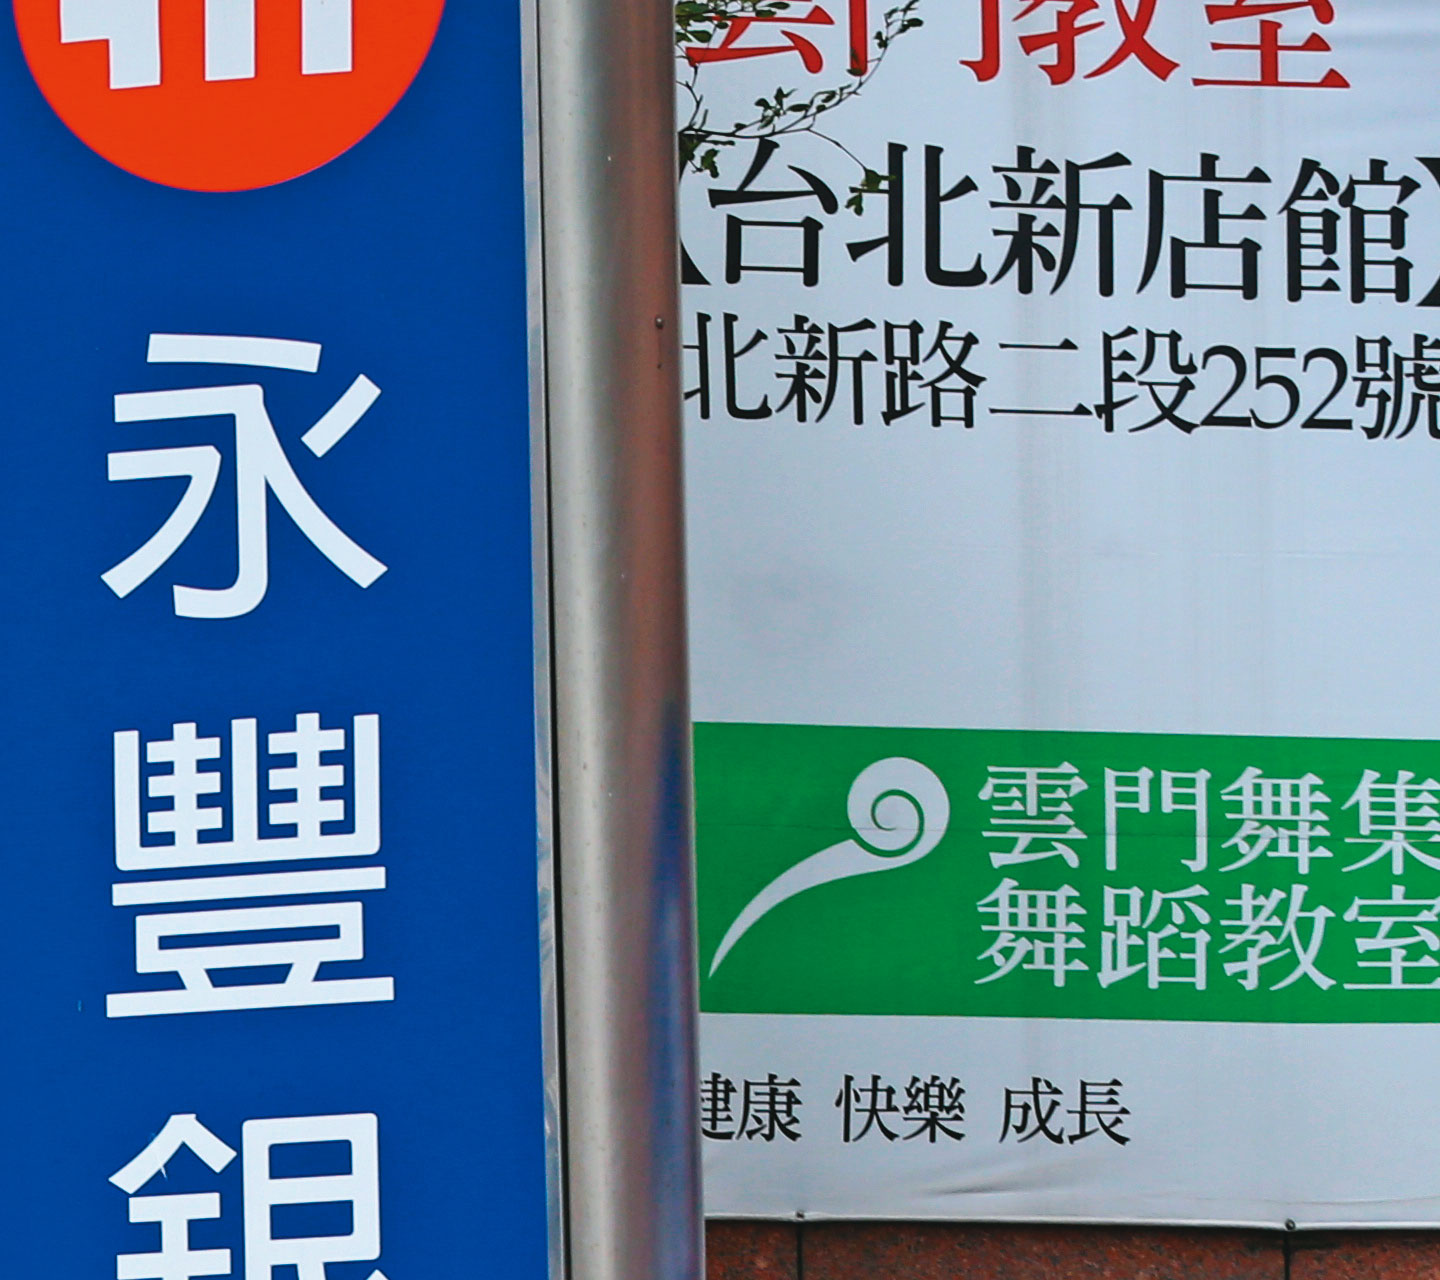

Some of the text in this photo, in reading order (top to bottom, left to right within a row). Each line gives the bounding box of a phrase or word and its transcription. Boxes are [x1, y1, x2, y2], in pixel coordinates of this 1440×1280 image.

[977, 761, 1440, 875] 雲門舞集
[974, 878, 1440, 991] 舞蹈教室
[834, 1075, 967, 1143] 快樂
[998, 1076, 1131, 1146] 成長
